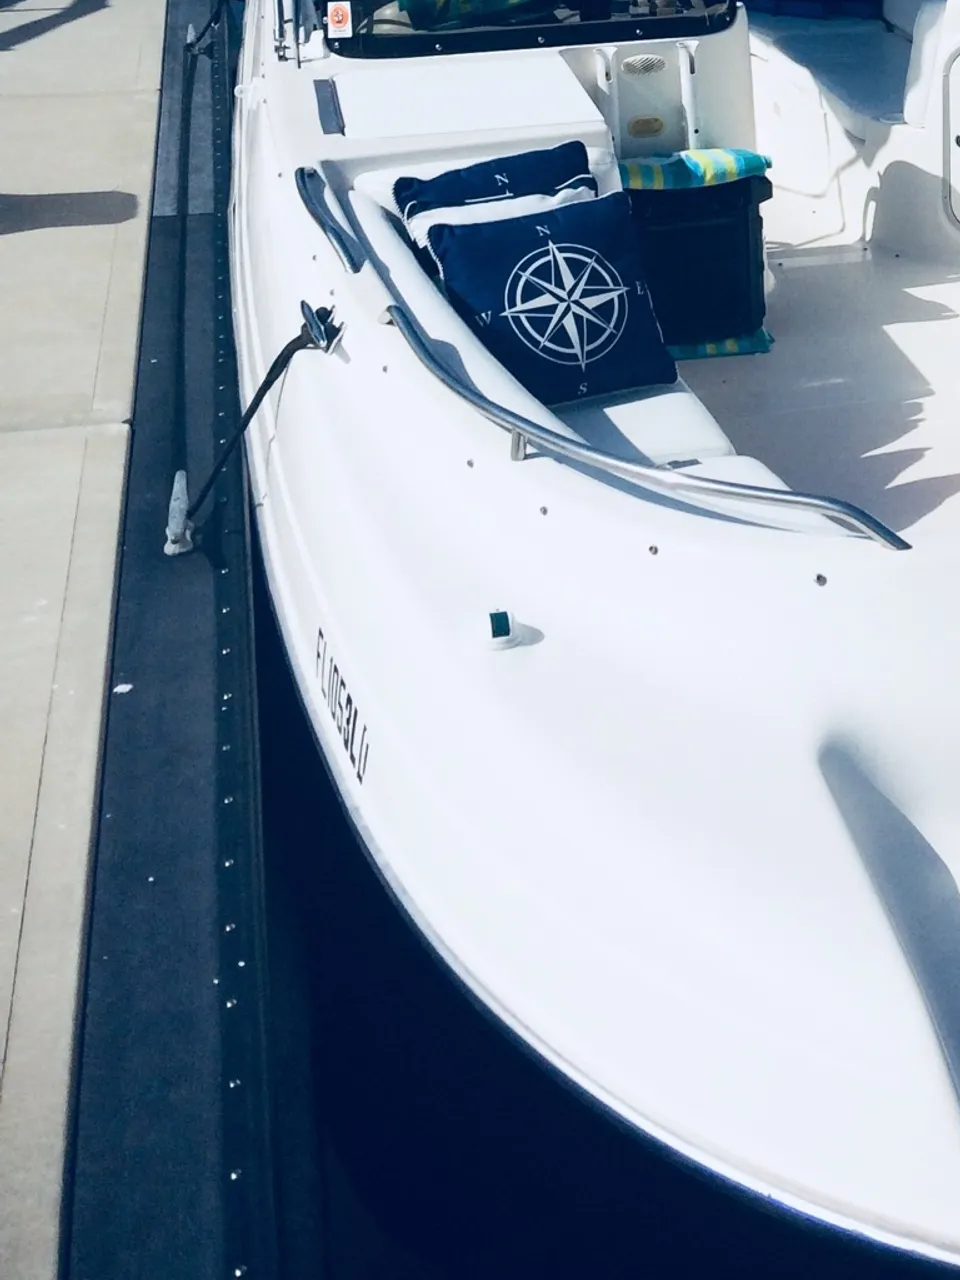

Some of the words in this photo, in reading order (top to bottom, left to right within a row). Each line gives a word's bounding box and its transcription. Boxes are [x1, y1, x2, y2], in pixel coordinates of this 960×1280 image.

[495, 173, 509, 186] N
[535, 224, 551, 236] N
[635, 281, 645, 295] E
[475, 311, 492, 327] W
[577, 383, 588, 395] S
